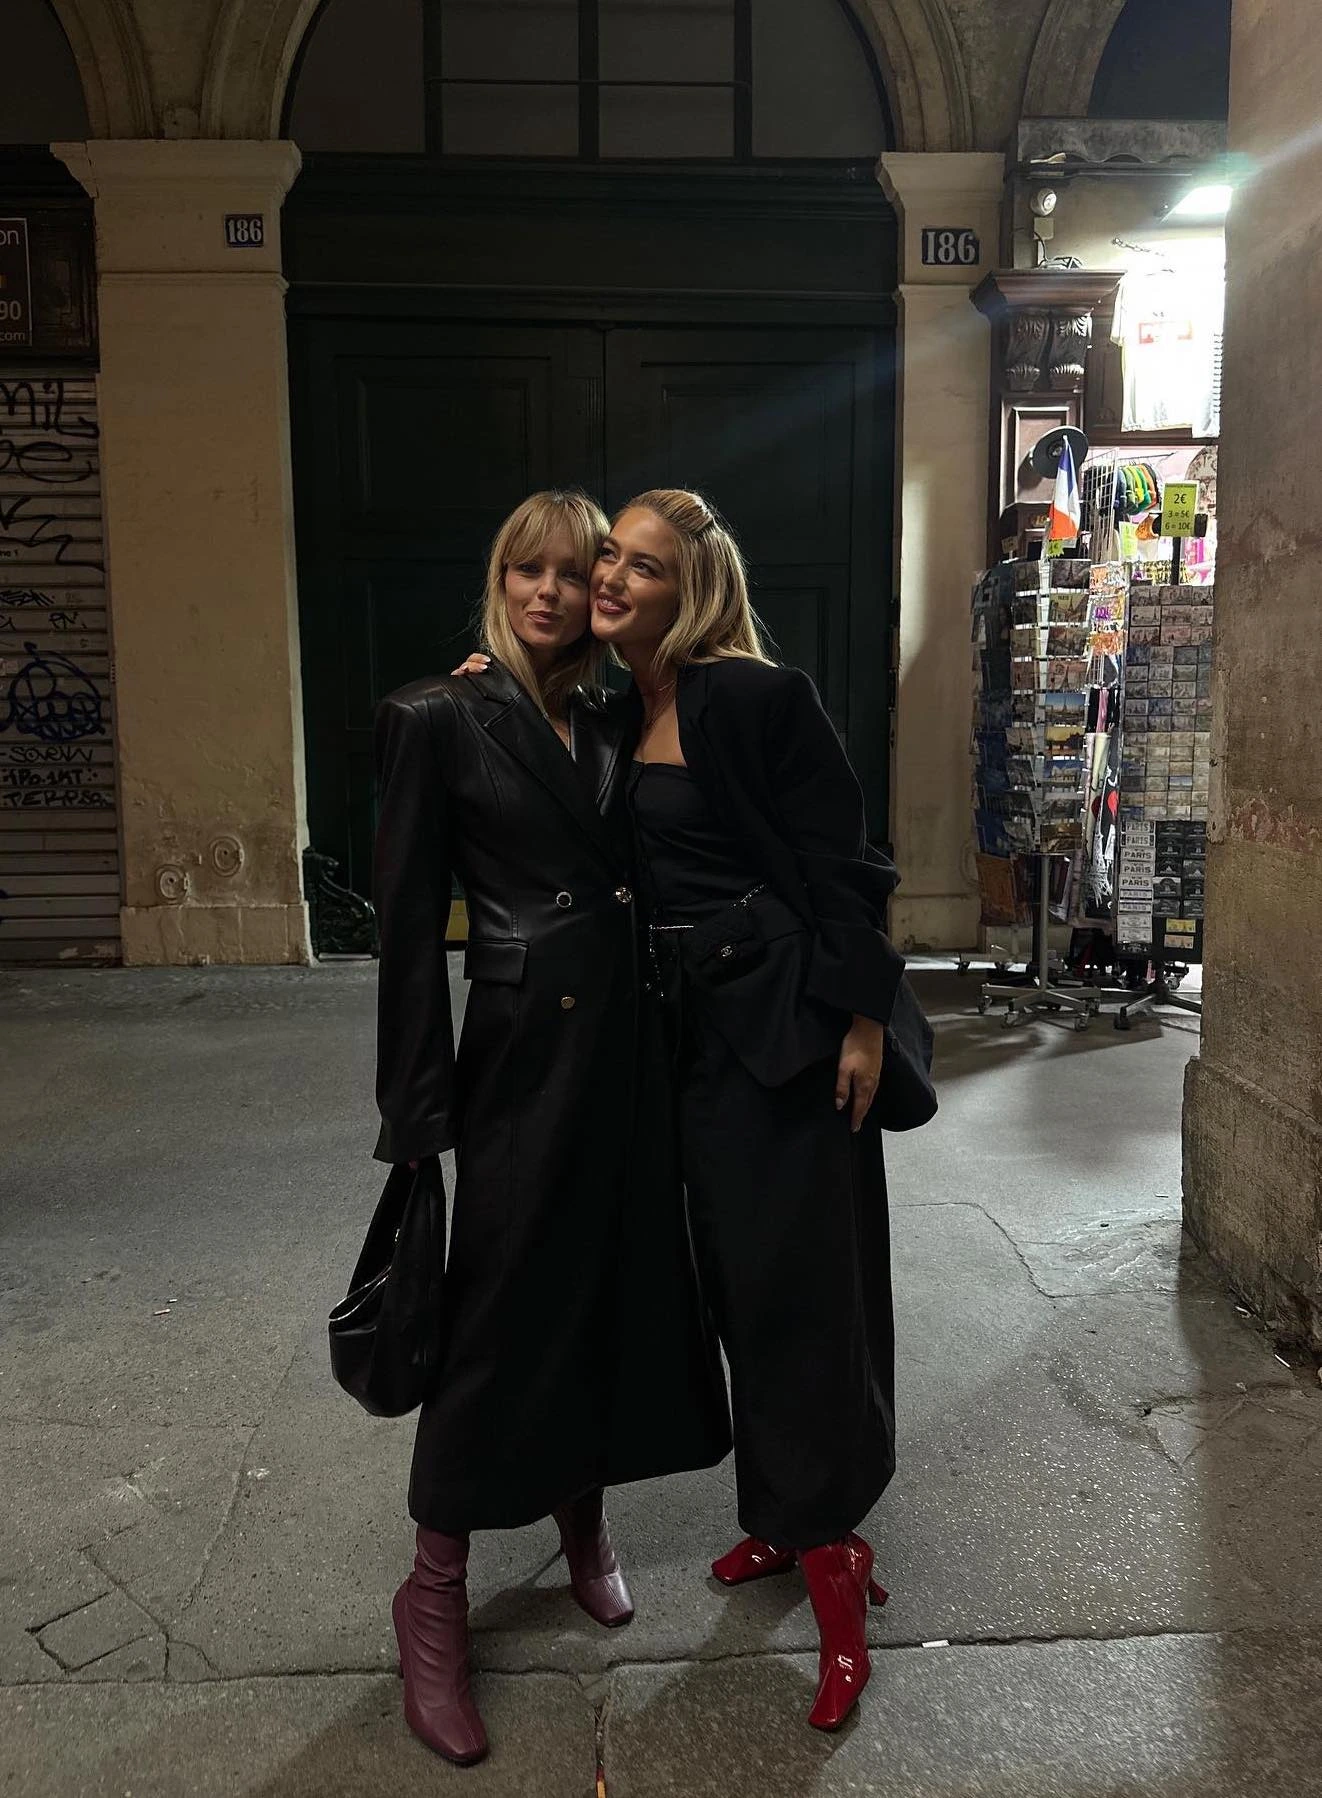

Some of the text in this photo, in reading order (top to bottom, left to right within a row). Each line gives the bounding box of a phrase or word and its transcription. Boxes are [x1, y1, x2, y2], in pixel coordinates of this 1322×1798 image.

[228, 219, 262, 243] 186
[926, 231, 976, 264] 186
[1174, 493, 1187, 504] 2€
[1168, 510, 1173, 518] 3
[1181, 510, 1190, 518] 5€
[1165, 522, 1170, 530] 6
[1178, 522, 1190, 530] 10€
[1127, 822, 1149, 832] PARIS
[1127, 836, 1149, 845] PARIS
[1124, 851, 1152, 860] PARIS
[1124, 865, 1152, 874] PARIS
[1122, 879, 1150, 887] PARIS
